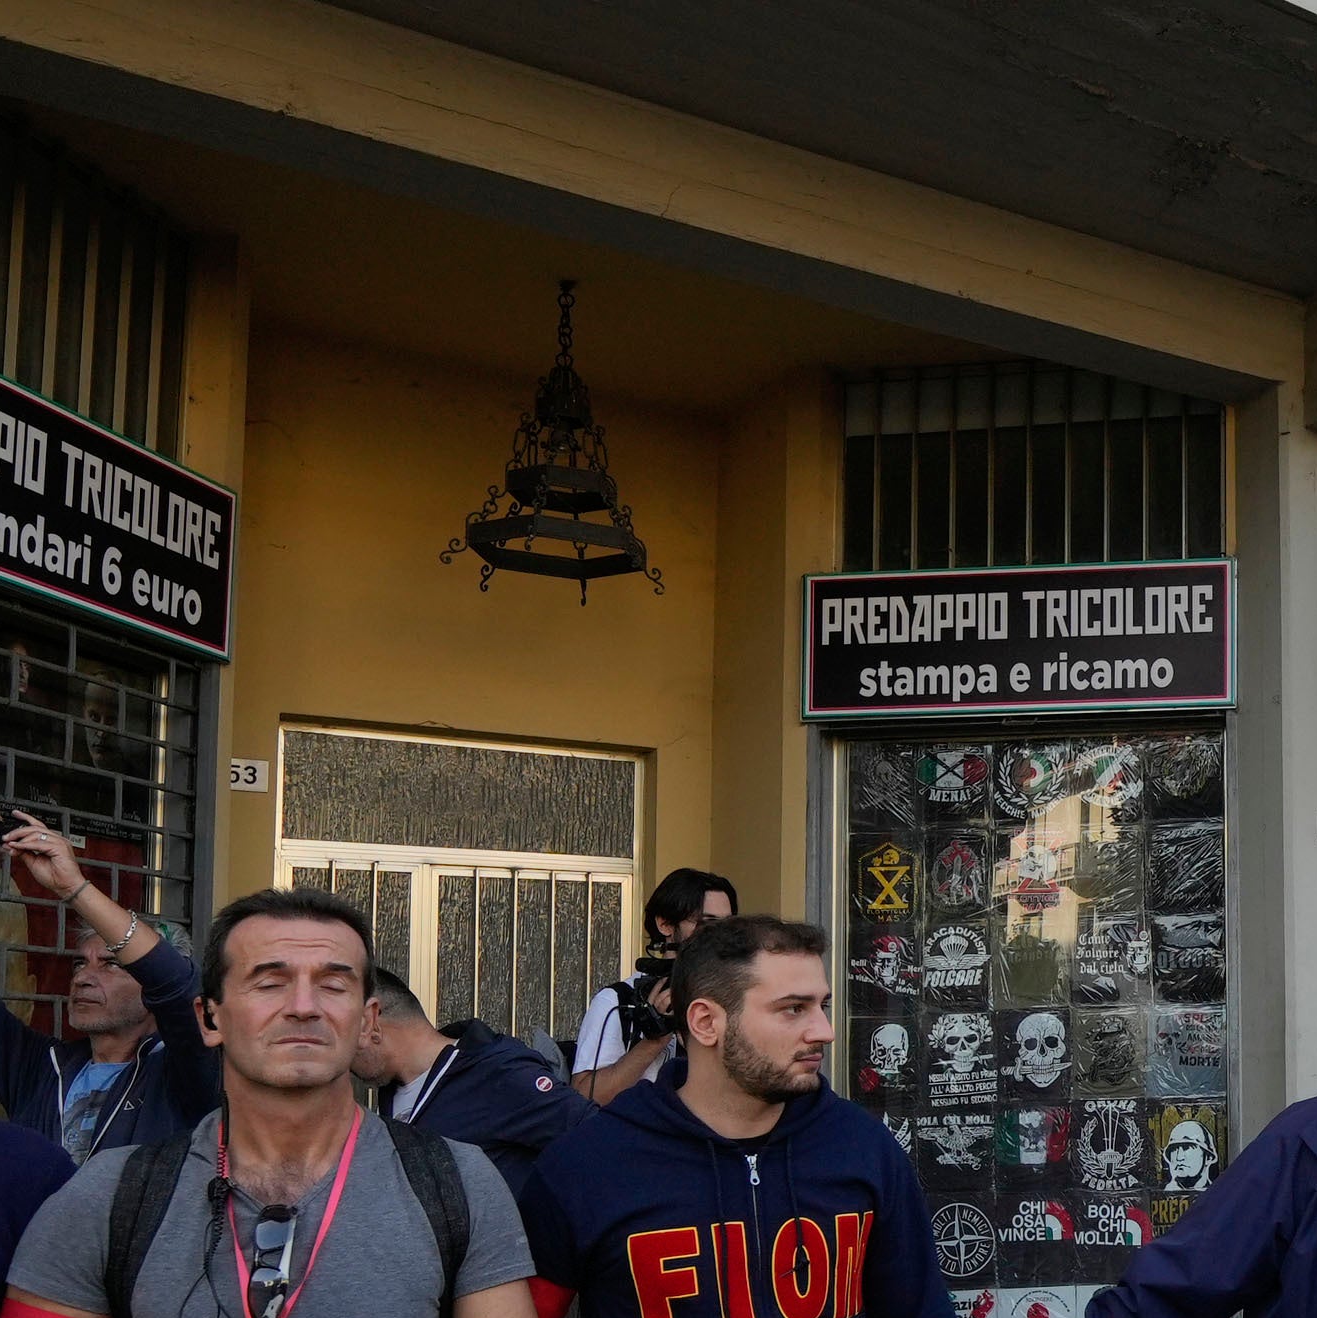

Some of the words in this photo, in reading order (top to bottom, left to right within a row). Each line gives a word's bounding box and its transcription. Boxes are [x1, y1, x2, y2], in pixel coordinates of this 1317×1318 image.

[61, 441, 222, 570] TRICOLORE
[101, 548, 123, 597] 6
[132, 571, 203, 626] euro
[821, 591, 1009, 646] PREDAPPIO
[1022, 584, 1215, 639] TRICOLORE
[859, 659, 998, 702] stampa
[1009, 662, 1032, 692] e
[1043, 652, 1175, 691] ricamo
[230, 764, 258, 785] 53
[928, 788, 973, 803] MENA!
[992, 790, 1028, 820] VECCHIE
[924, 968, 984, 988] FOLGORE
[1178, 1055, 1221, 1068] MORTE
[965, 1114, 995, 1126] MOLL
[1018, 1200, 1045, 1215] CHI
[1087, 1204, 1126, 1219] BOIA
[932, 1210, 952, 1237] MOLTI
[962, 1208, 990, 1236] NEMICI
[1012, 1214, 1045, 1228] OSA
[1098, 1218, 1125, 1232] CHI
[997, 1227, 1046, 1241] VINCE
[965, 1242, 991, 1272] ONORE
